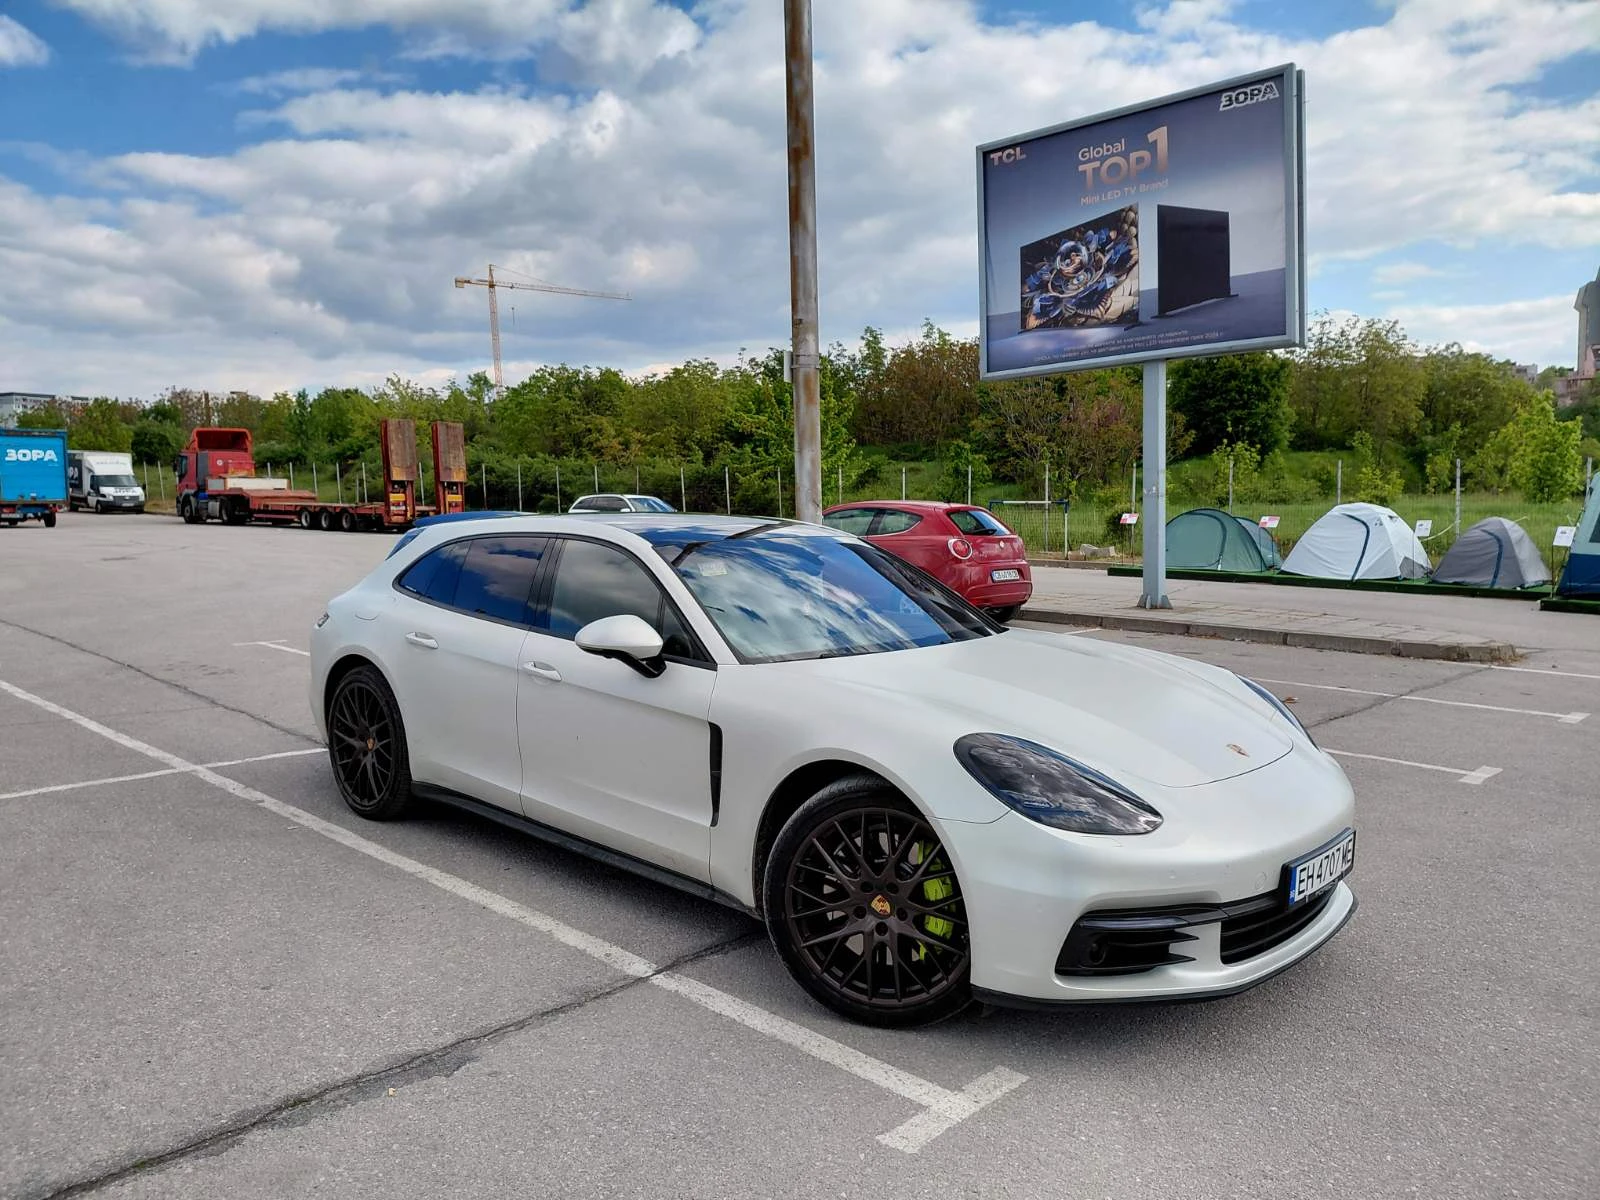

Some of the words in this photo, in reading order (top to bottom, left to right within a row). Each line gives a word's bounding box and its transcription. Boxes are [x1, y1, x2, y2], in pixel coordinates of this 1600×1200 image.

[1220, 82, 1279, 111] ЗОРА
[990, 147, 1027, 166] TCL
[1078, 138, 1125, 161] Global
[1080, 194, 1099, 206] Mini
[1102, 189, 1121, 201] LED
[1124, 184, 1137, 197] TV
[1139, 178, 1169, 193] Brand
[5, 449, 58, 462] ЗОРА
